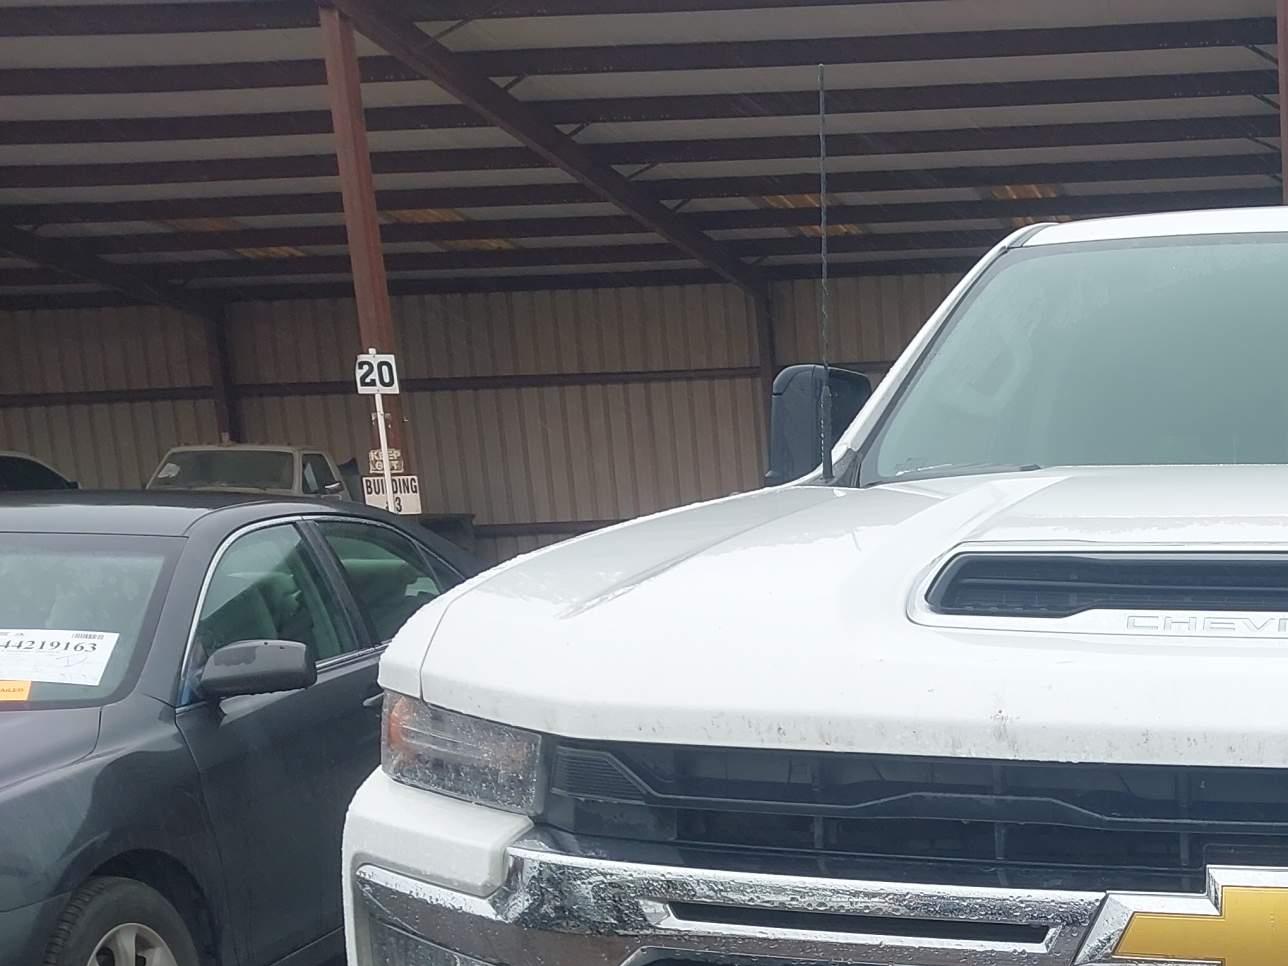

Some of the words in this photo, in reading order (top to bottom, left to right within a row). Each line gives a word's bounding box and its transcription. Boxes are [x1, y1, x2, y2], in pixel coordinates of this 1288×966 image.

[357, 360, 395, 388] 20
[375, 460, 400, 471] OT
[365, 477, 418, 495] BUIDING
